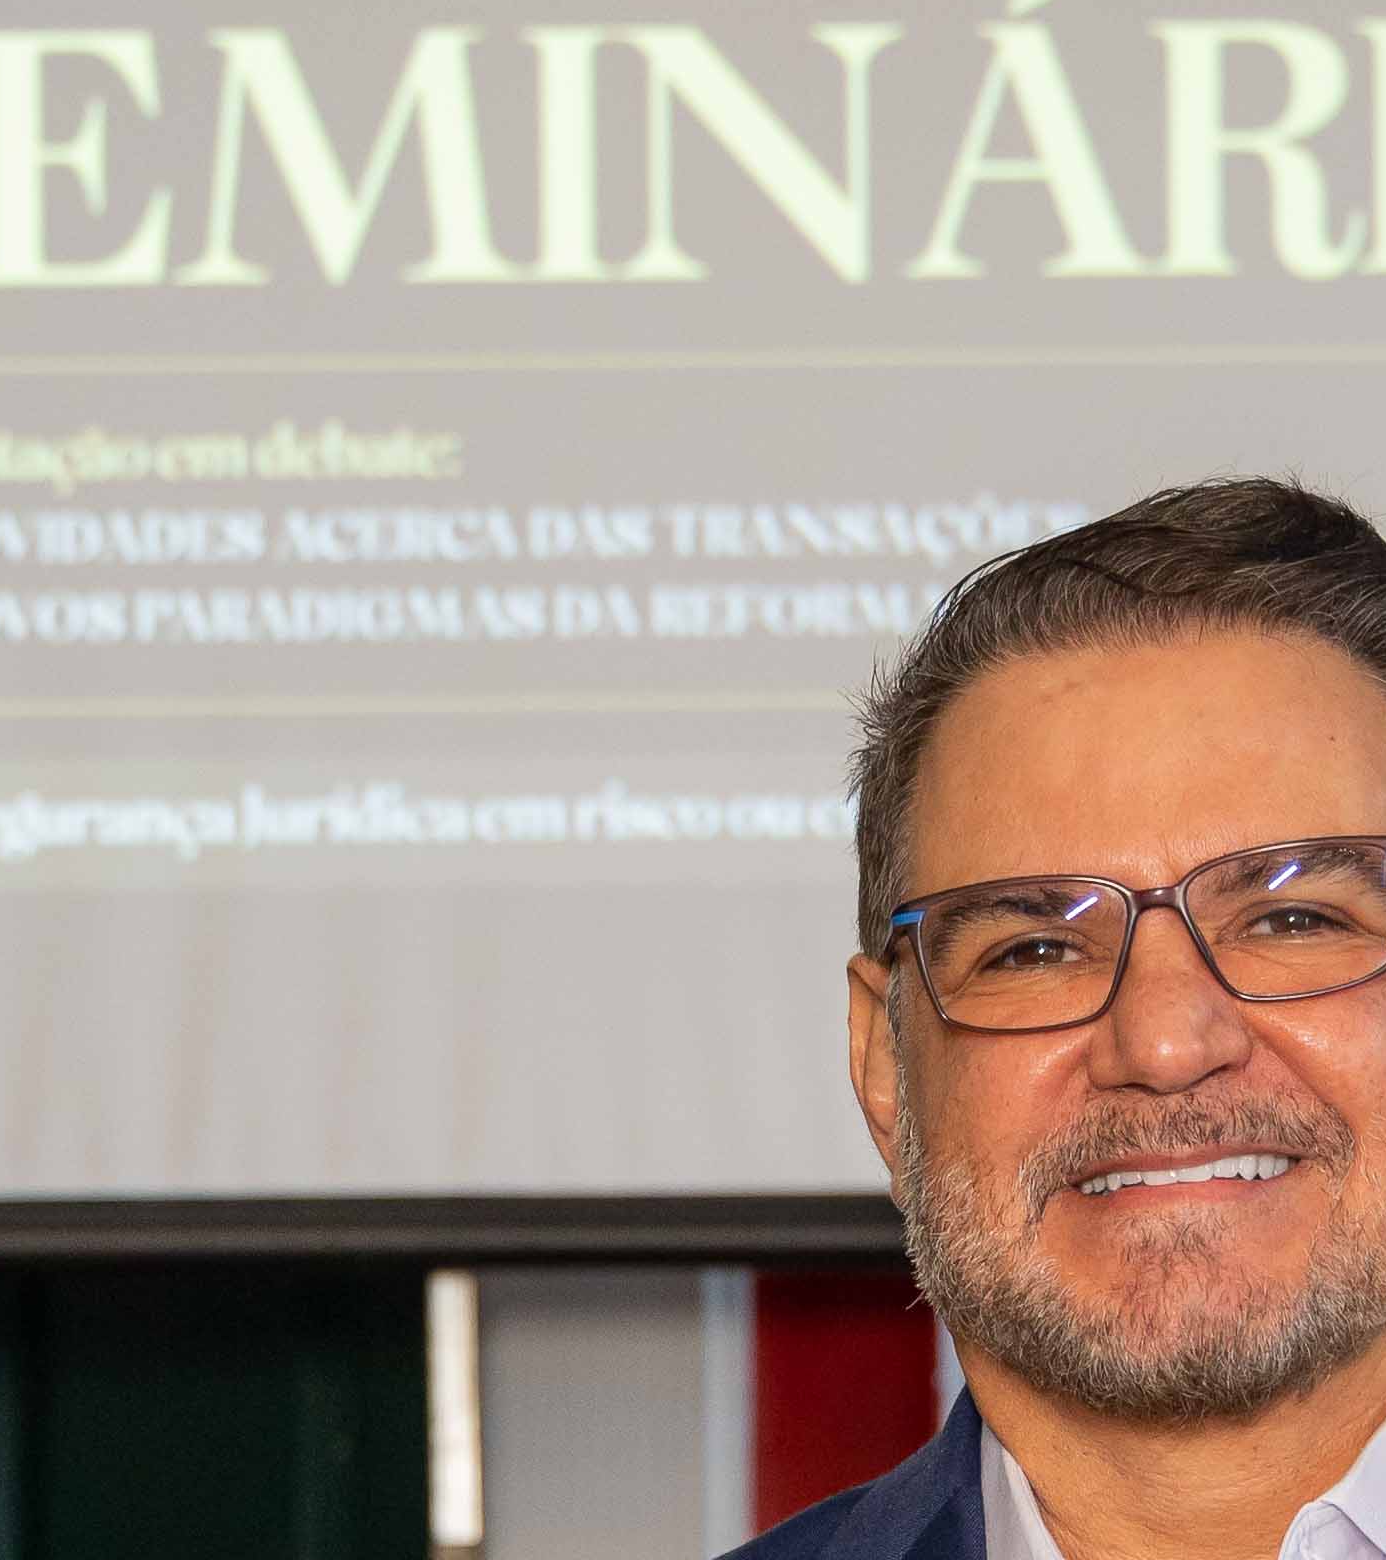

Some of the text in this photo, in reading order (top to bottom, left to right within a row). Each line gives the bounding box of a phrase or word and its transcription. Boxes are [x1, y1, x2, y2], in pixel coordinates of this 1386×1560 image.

[273, 504, 518, 563] ACERCA
[524, 502, 657, 560] DAS
[551, 582, 643, 639] DA
[645, 580, 947, 637] REFORM
